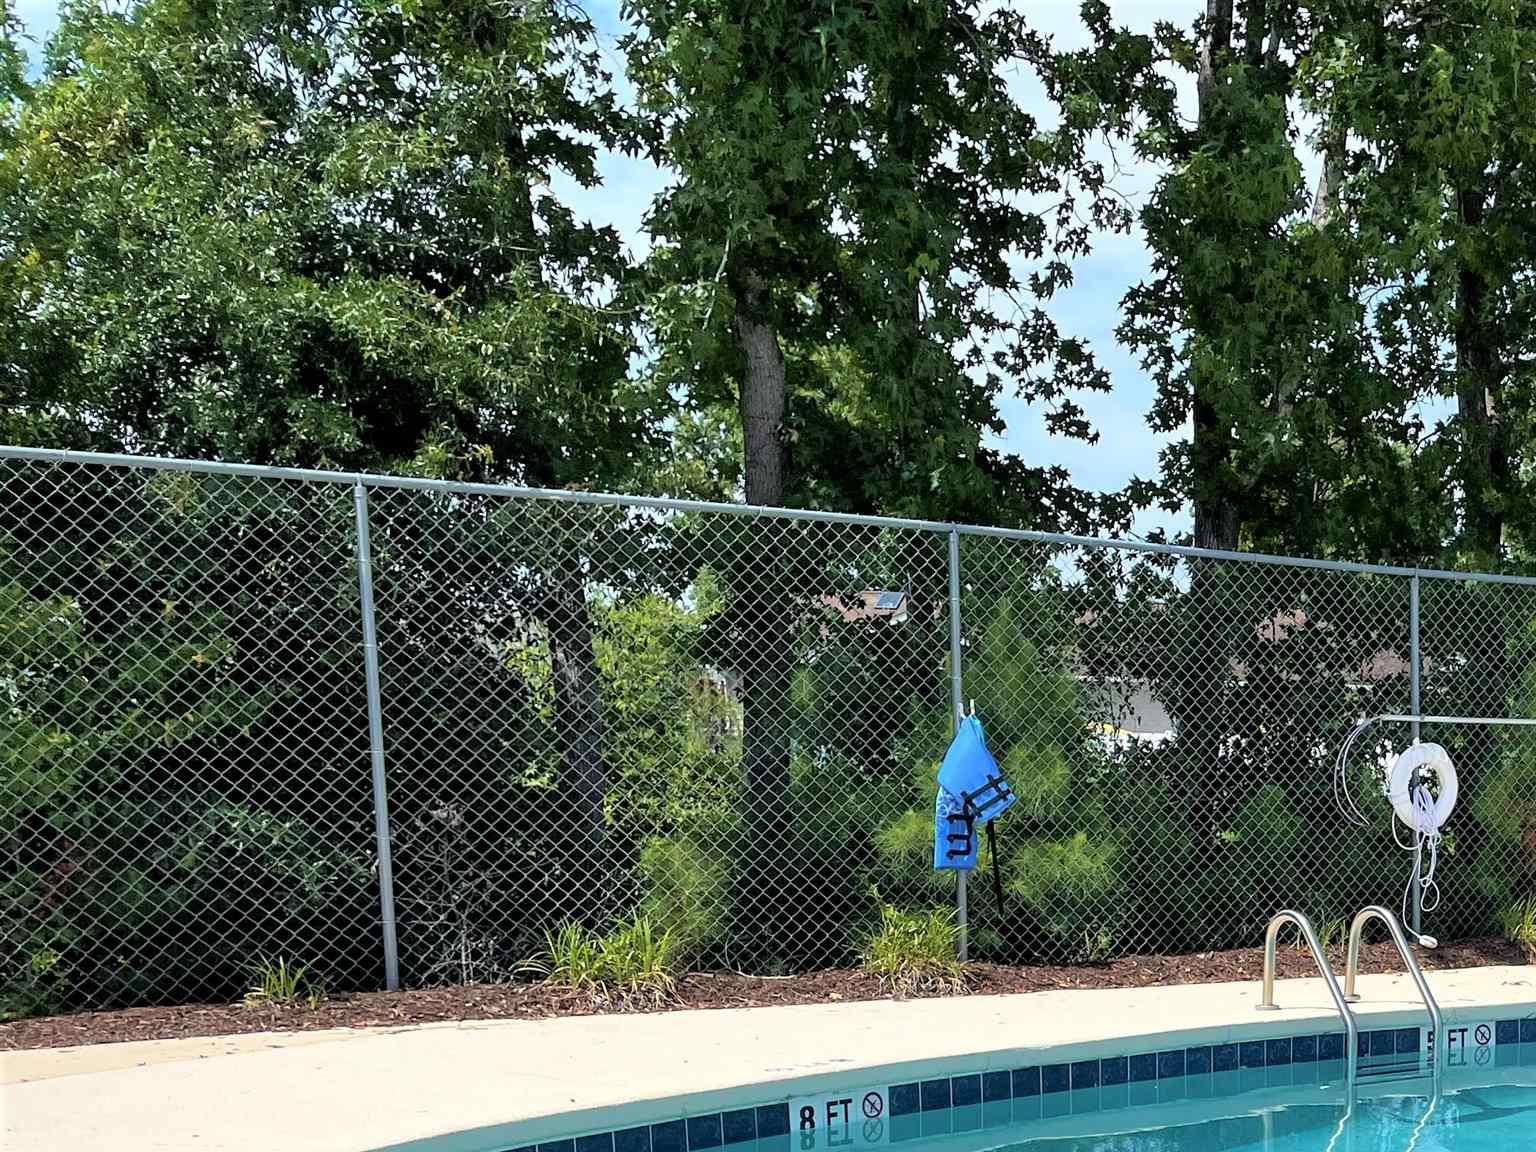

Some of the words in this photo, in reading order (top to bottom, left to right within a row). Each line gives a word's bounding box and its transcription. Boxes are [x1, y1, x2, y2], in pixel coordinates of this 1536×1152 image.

[1448, 1028, 1468, 1049] FT
[800, 1106, 815, 1130] 8
[826, 1098, 853, 1127] FT
